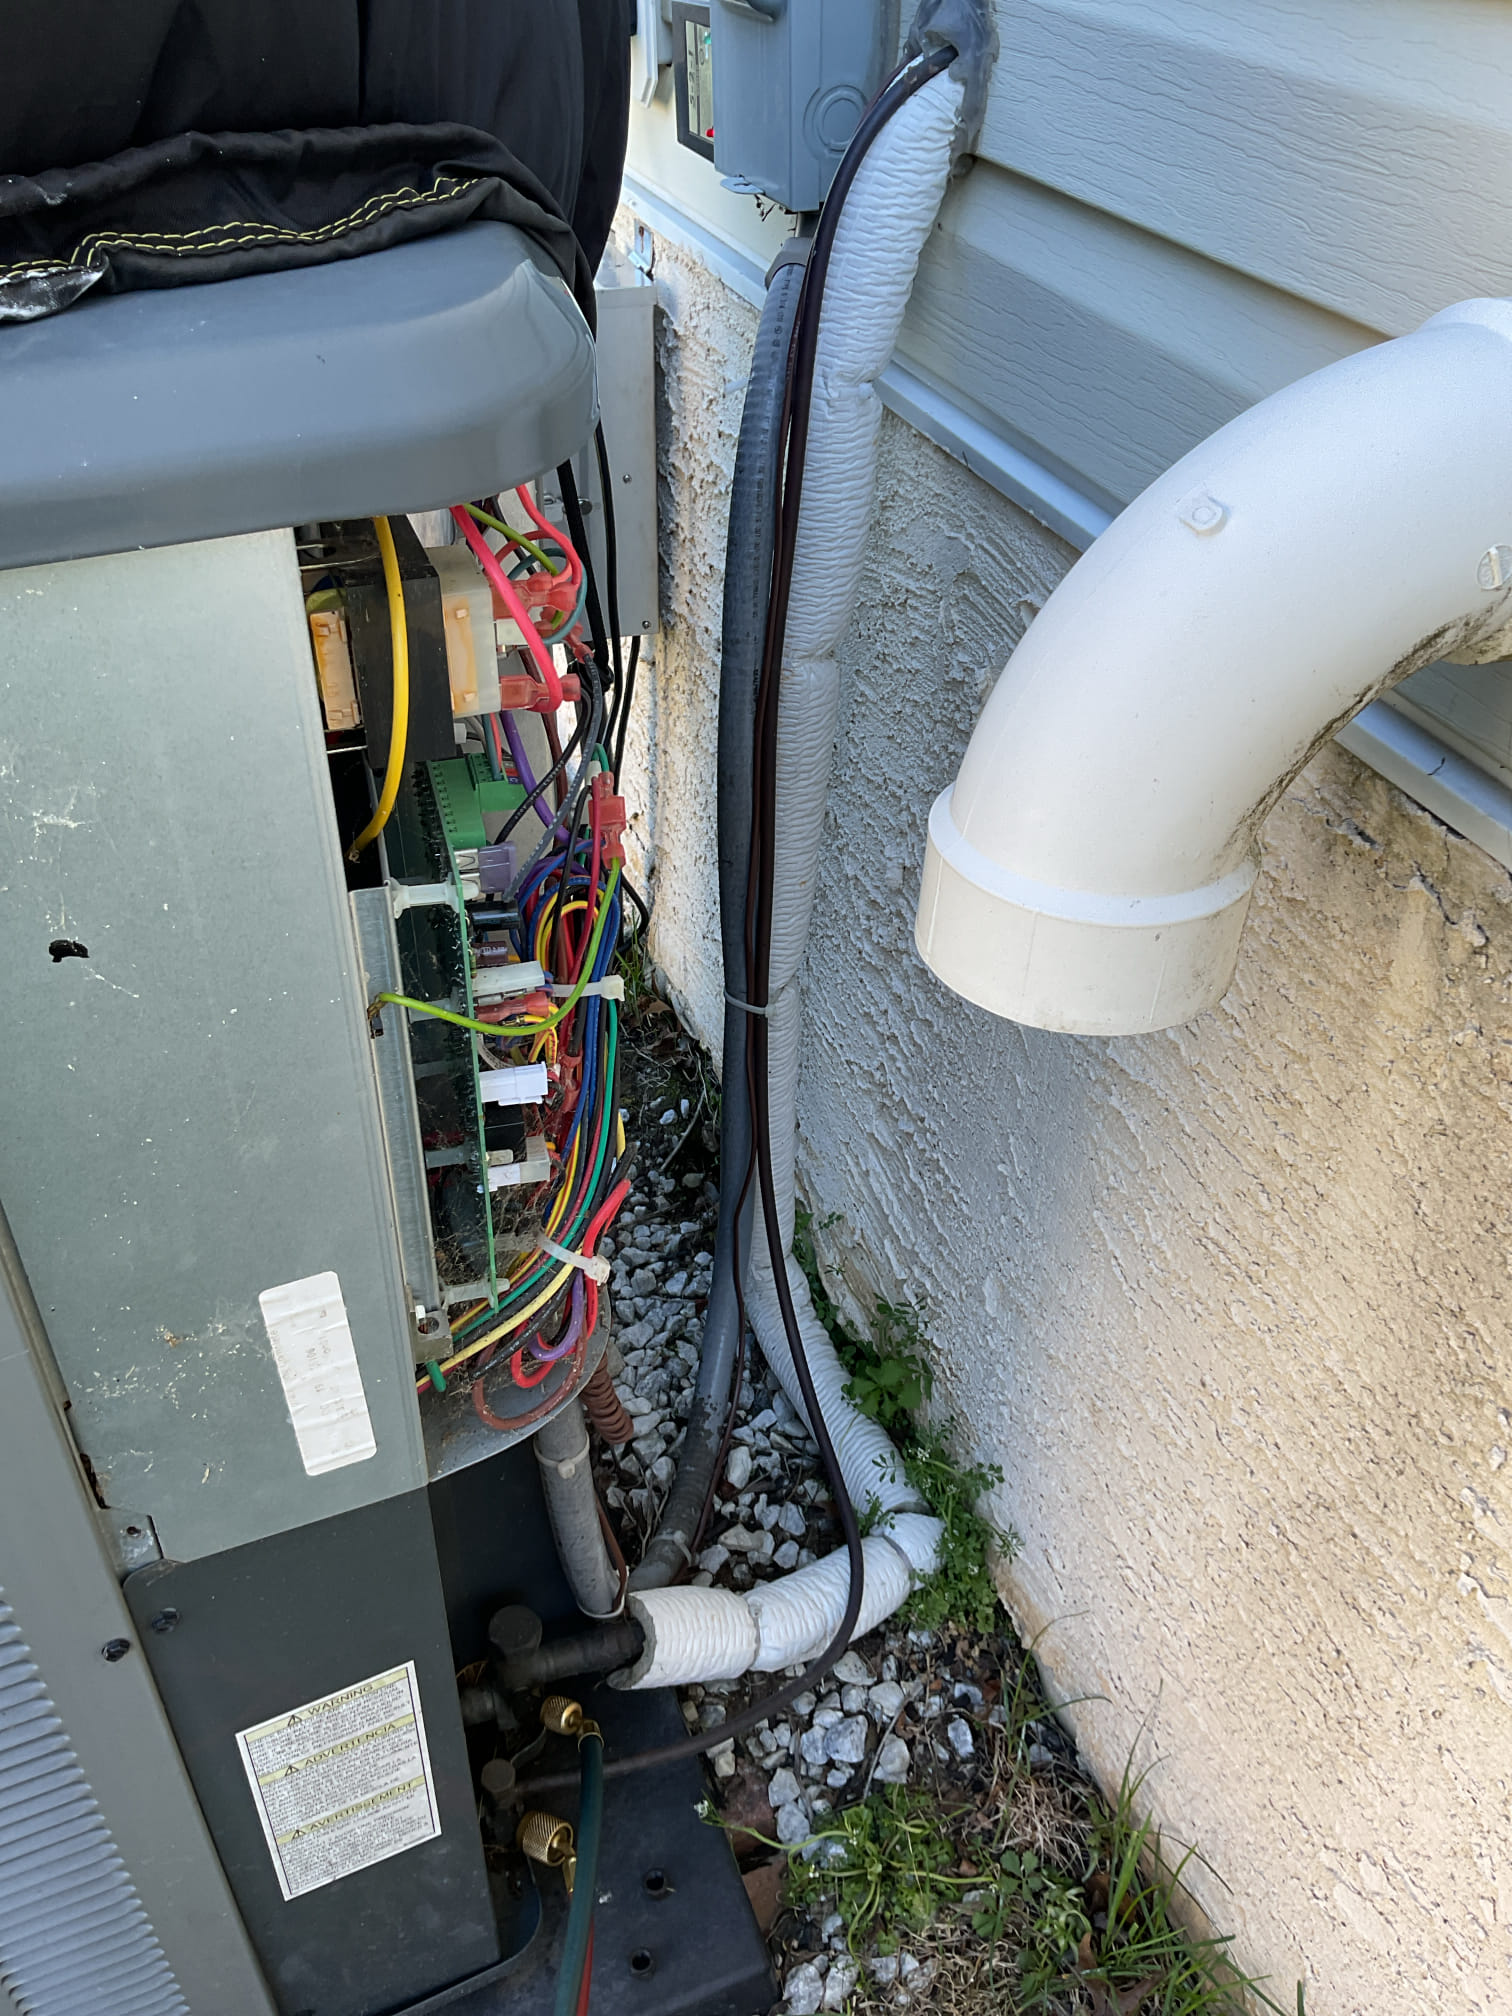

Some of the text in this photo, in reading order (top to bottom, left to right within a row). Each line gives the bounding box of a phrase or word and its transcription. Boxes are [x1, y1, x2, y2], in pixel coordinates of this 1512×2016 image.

[308, 1683, 373, 1716] WARNING
[304, 1722, 396, 1767] ADVERTENCIA
[309, 1781, 413, 1831] AVERTISSEMENT
